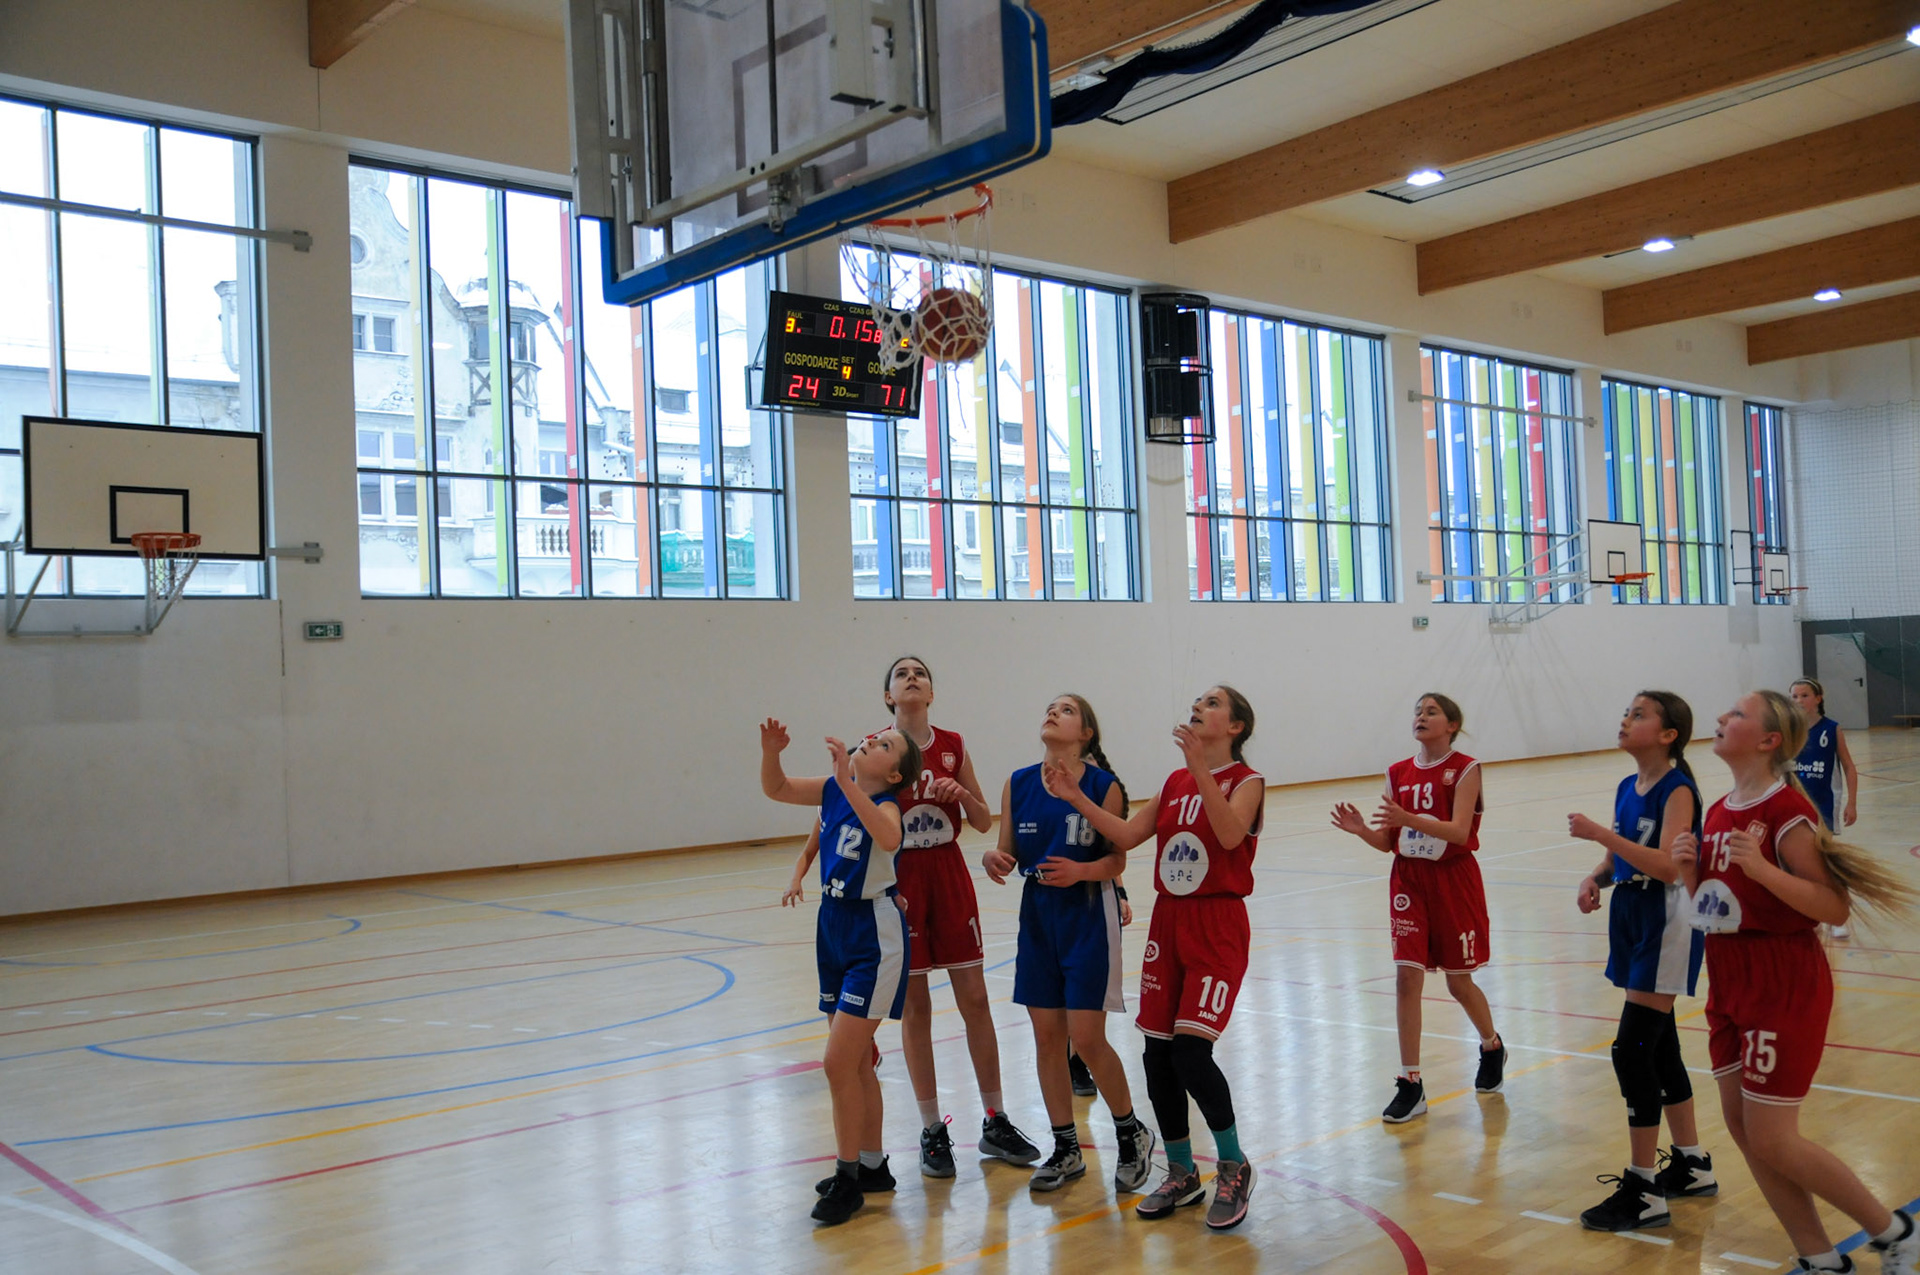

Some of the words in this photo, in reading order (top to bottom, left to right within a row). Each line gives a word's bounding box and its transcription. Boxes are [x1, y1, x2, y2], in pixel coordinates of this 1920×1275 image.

[787, 310, 804, 320] FAUL
[823, 303, 840, 312] CZAS
[849, 306, 865, 315] CZAS
[784, 352, 839, 371] GOSPODARZE
[841, 356, 855, 365] SET
[842, 365, 852, 380] 4
[788, 374, 820, 399] 24
[832, 385, 847, 398] 3D
[880, 384, 907, 407] 71
[1819, 729, 1829, 748] 6
[1411, 782, 1434, 810] 13
[1177, 794, 1203, 826] 10
[835, 823, 863, 860] 12
[1065, 813, 1096, 847] 18
[1636, 817, 1657, 846] 7
[1710, 831, 1732, 873] 15
[1198, 975, 1230, 1015] 10
[1197, 1010, 1219, 1022] JAKO
[1743, 1029, 1777, 1074] 15
